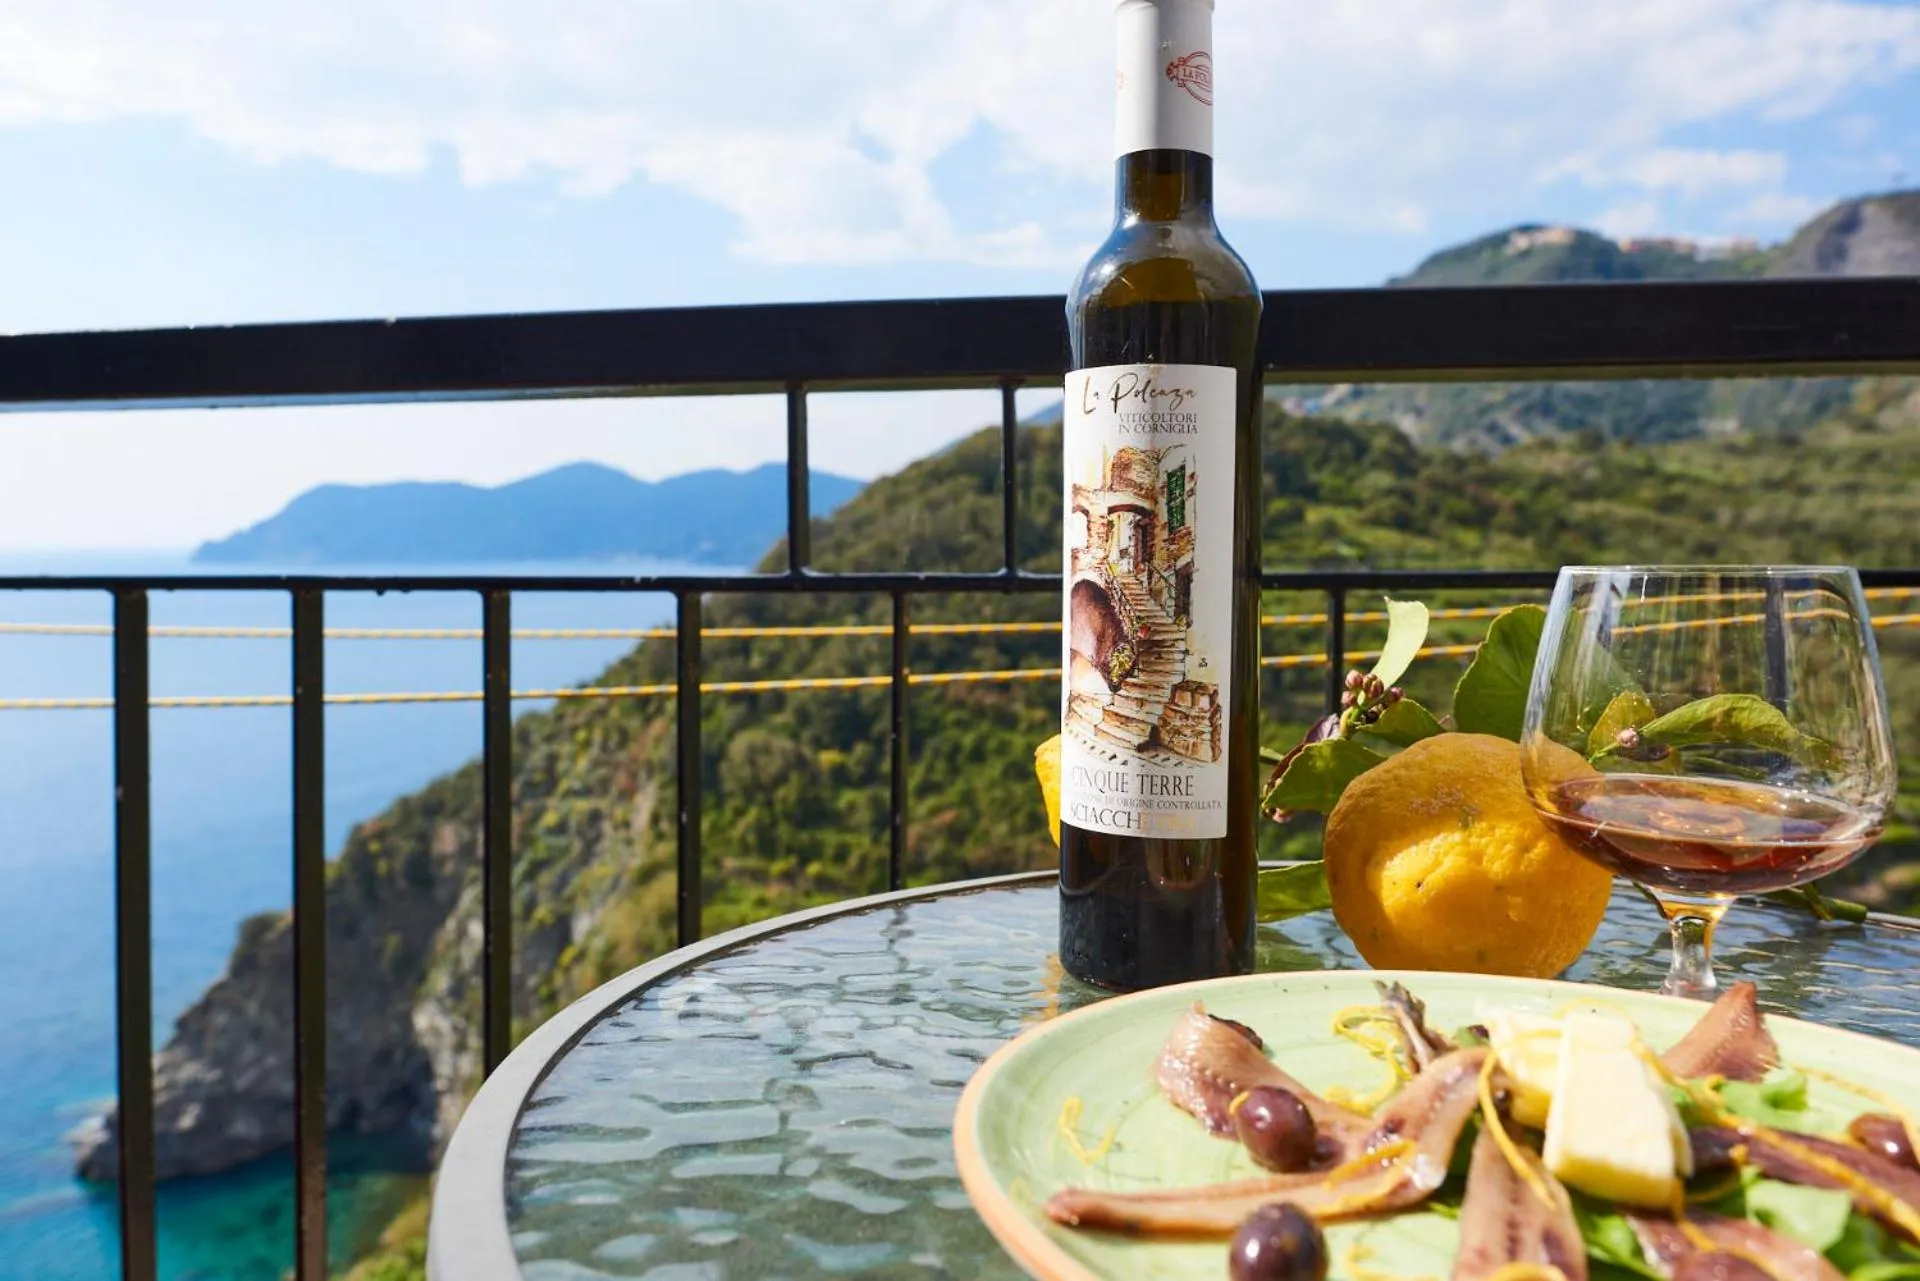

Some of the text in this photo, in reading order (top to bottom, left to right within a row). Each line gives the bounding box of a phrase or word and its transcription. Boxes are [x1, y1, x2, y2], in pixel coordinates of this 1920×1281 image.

[1118, 412, 1197, 423] VITICOLTORI
[1117, 424, 1198, 434] IN CORNIGLIA
[1072, 765, 1194, 796] CINQUE TERRE
[1156, 800, 1221, 810] CONTROLLATA
[1071, 801, 1193, 832] SCIACCH
